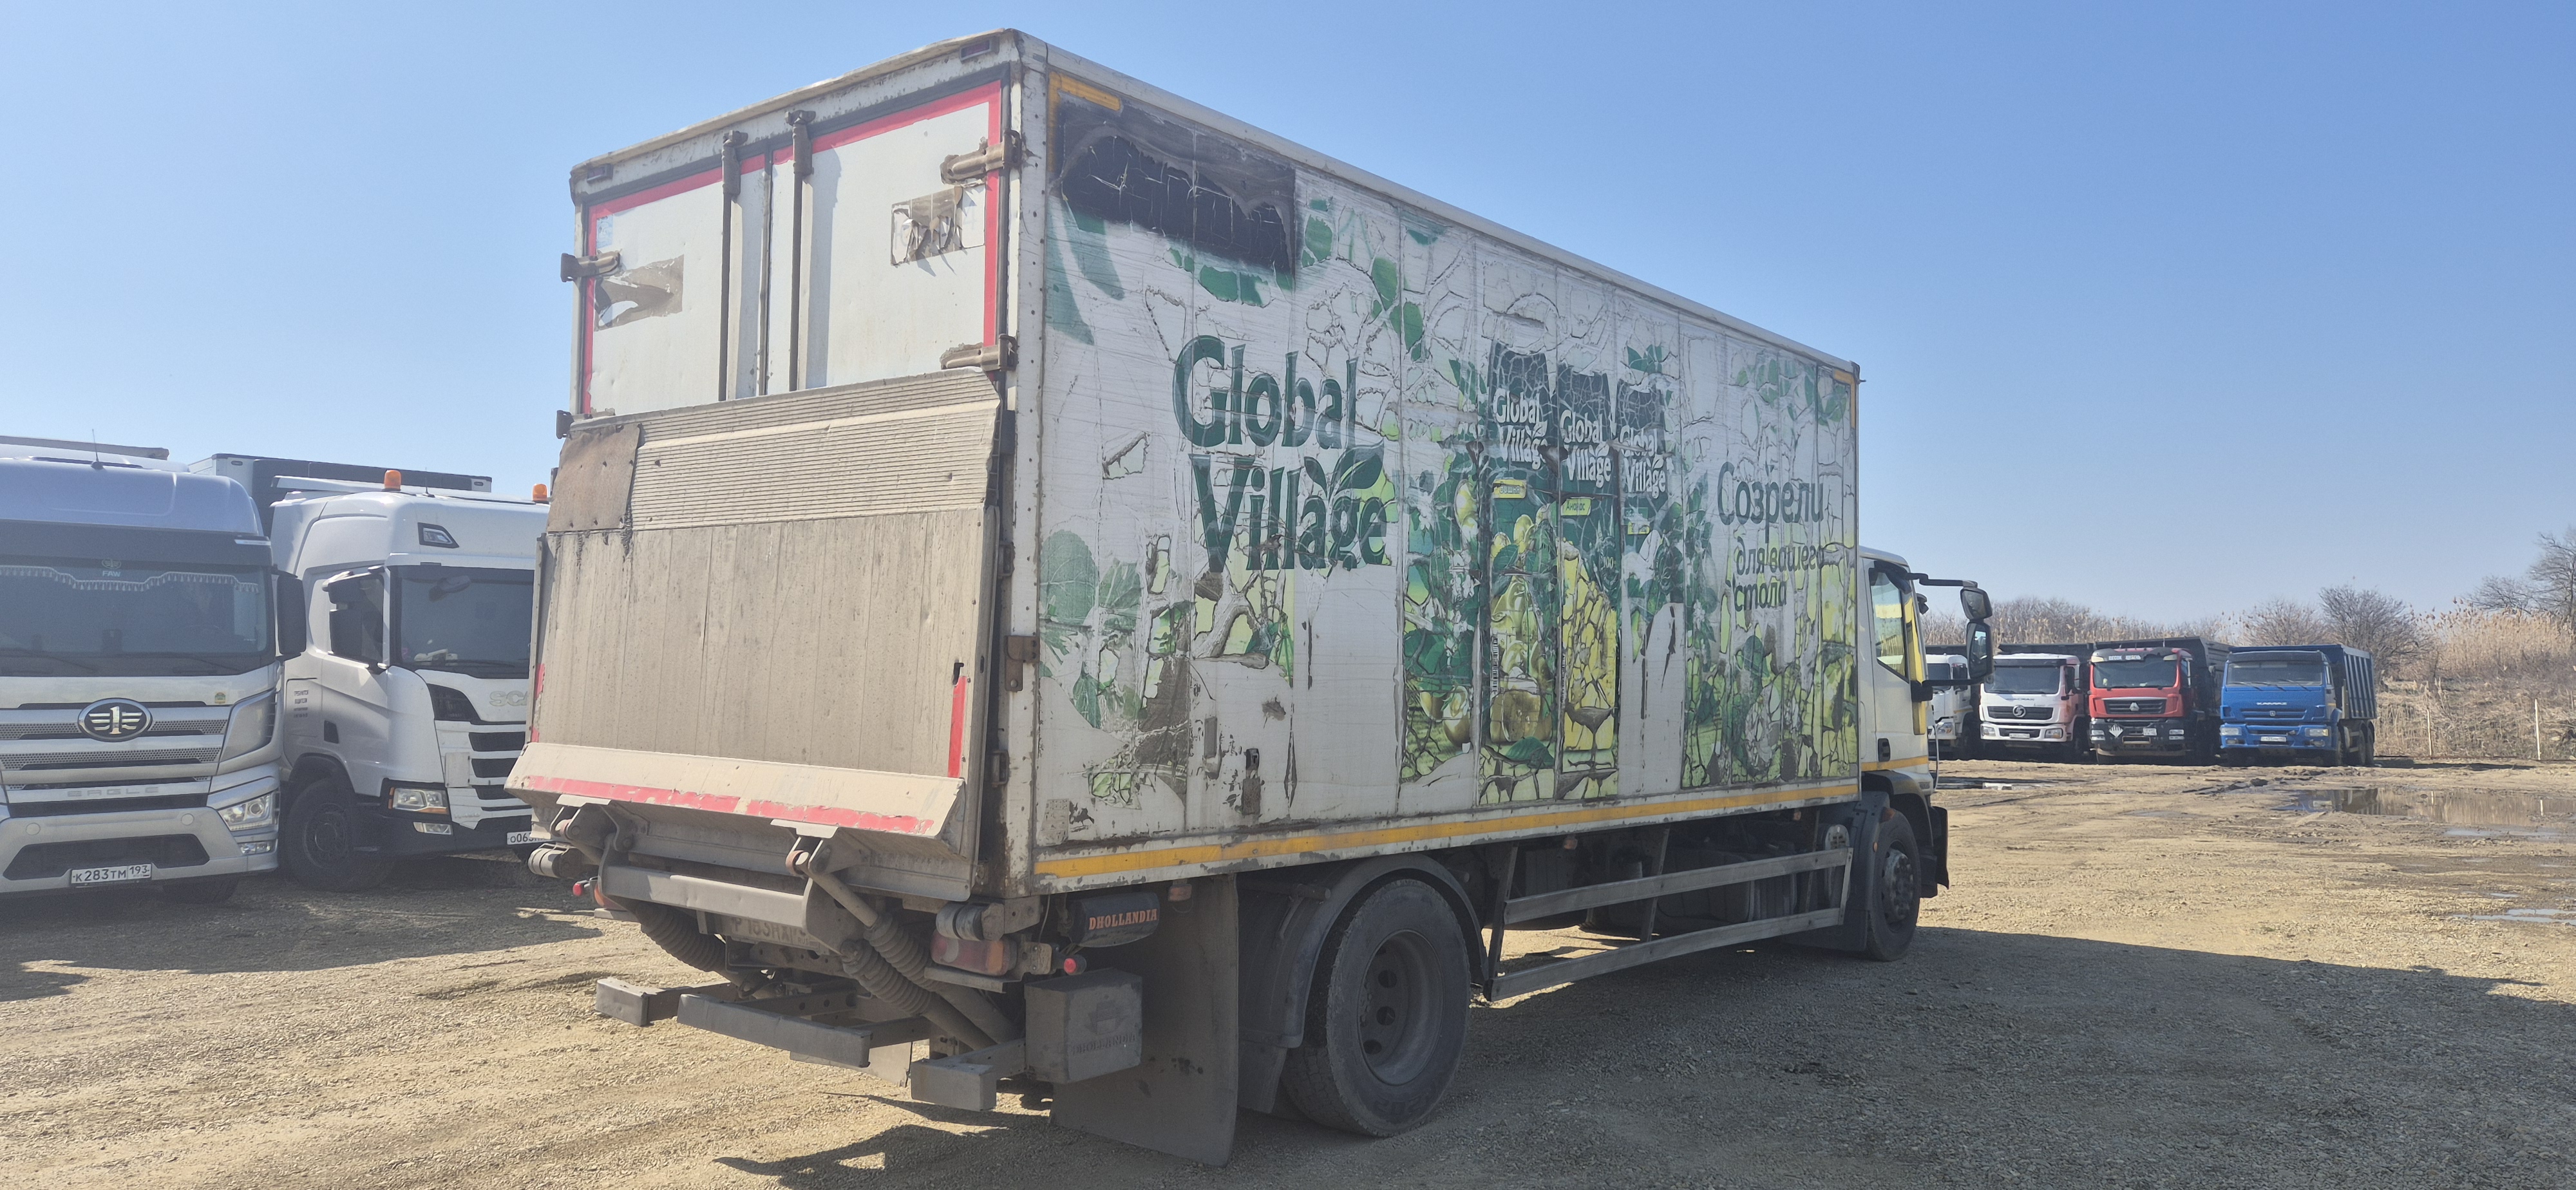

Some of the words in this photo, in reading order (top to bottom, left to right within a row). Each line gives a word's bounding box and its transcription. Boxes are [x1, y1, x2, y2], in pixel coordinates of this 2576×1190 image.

[1172, 335, 1359, 449] Global
[1493, 388, 1540, 423] Global
[1561, 410, 1603, 443] Global
[1564, 444, 1611, 488] Village
[1624, 457, 1666, 498] Village
[1188, 453, 1388, 572] Village
[1718, 462, 1824, 543] Созрели
[1736, 536, 1765, 575] для
[1734, 581, 1787, 612] стола
[67, 786, 159, 797] EAGLE
[129, 865, 148, 874] 193
[1088, 909, 1158, 930] DHOLLANDIA
[1072, 1032, 1135, 1055] DHOLLANDIA
